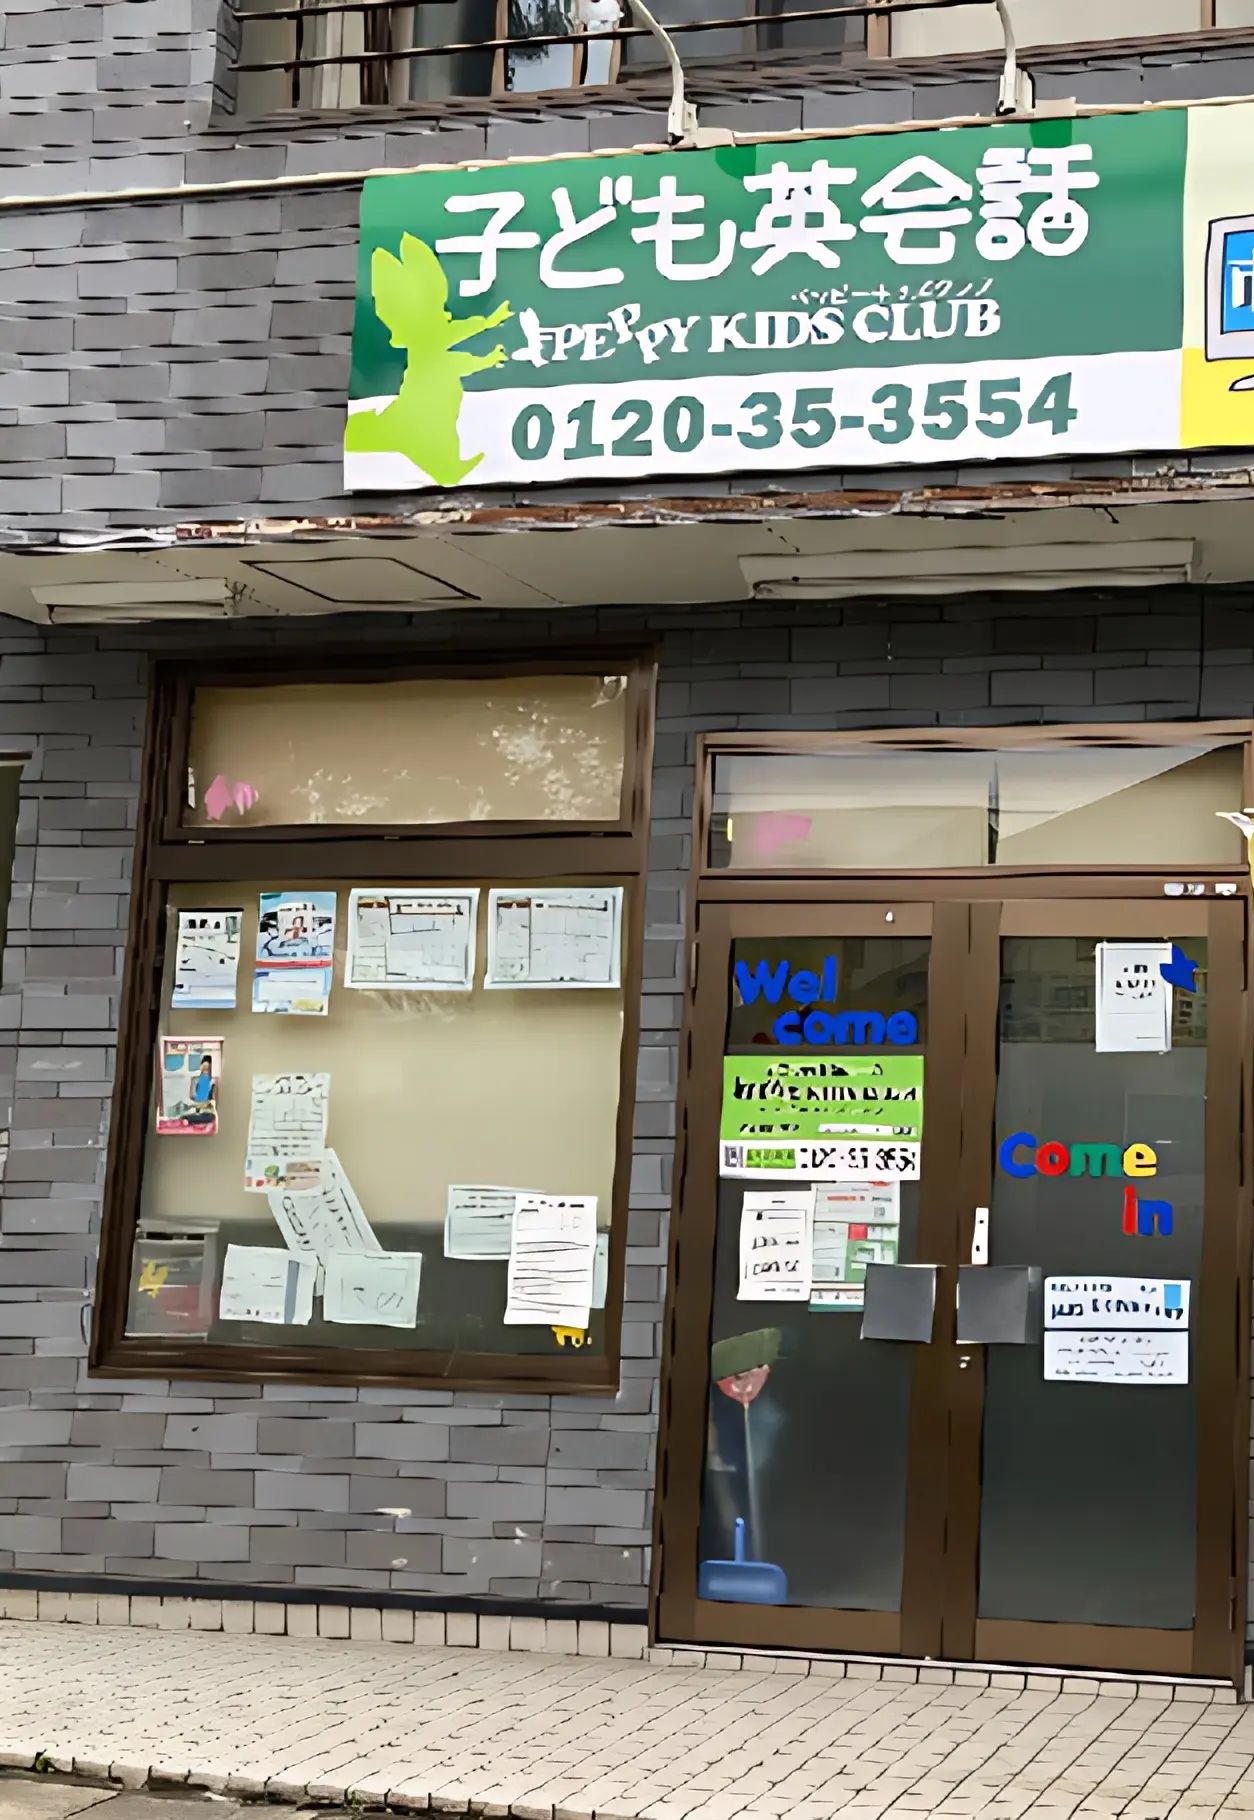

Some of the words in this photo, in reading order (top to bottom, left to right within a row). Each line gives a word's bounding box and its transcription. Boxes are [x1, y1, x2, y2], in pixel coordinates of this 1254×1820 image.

[434, 143, 1100, 297] 子ども英会話
[550, 304, 701, 364] PEPPY
[707, 310, 846, 353] KIDS
[852, 298, 1001, 345] CLUB
[510, 371, 1078, 461] 0120-35-3554
